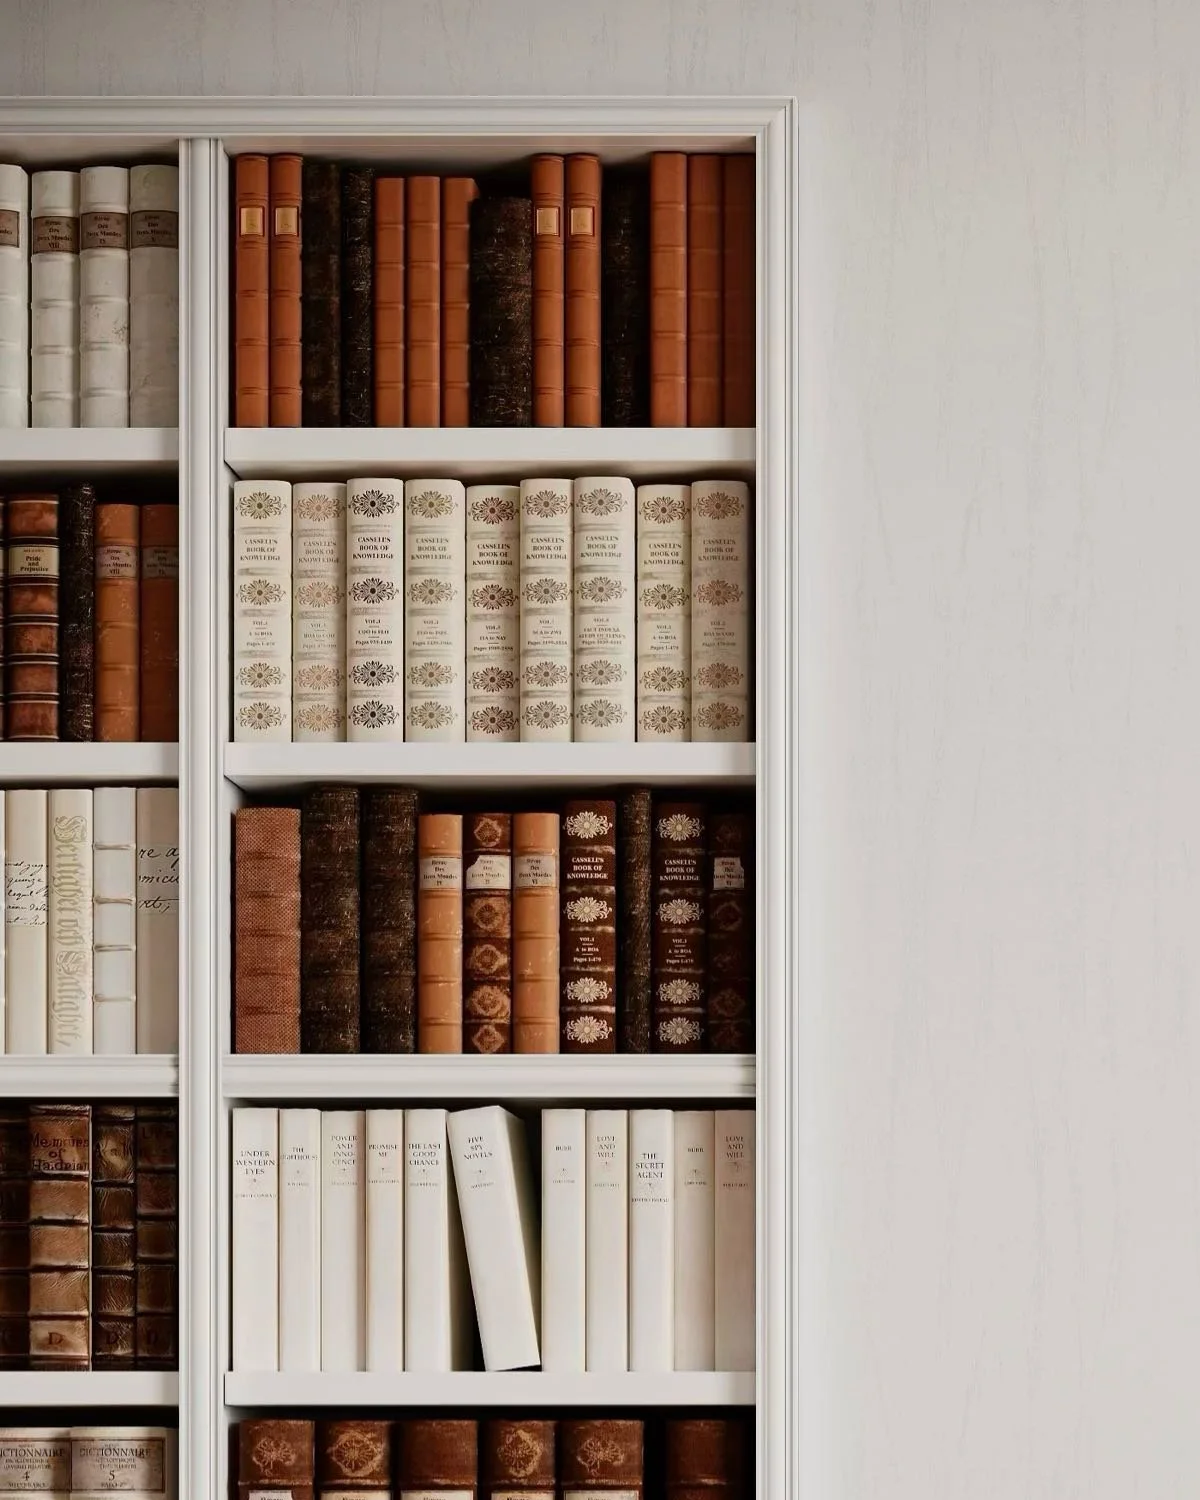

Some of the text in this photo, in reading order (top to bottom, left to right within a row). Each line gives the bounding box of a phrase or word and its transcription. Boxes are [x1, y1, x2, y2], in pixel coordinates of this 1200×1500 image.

[464, 1152, 493, 1160] NOVELS
[48, 1332, 64, 1346] D
[22, 1471, 30, 1481] 4
[108, 1469, 115, 1481] 5
